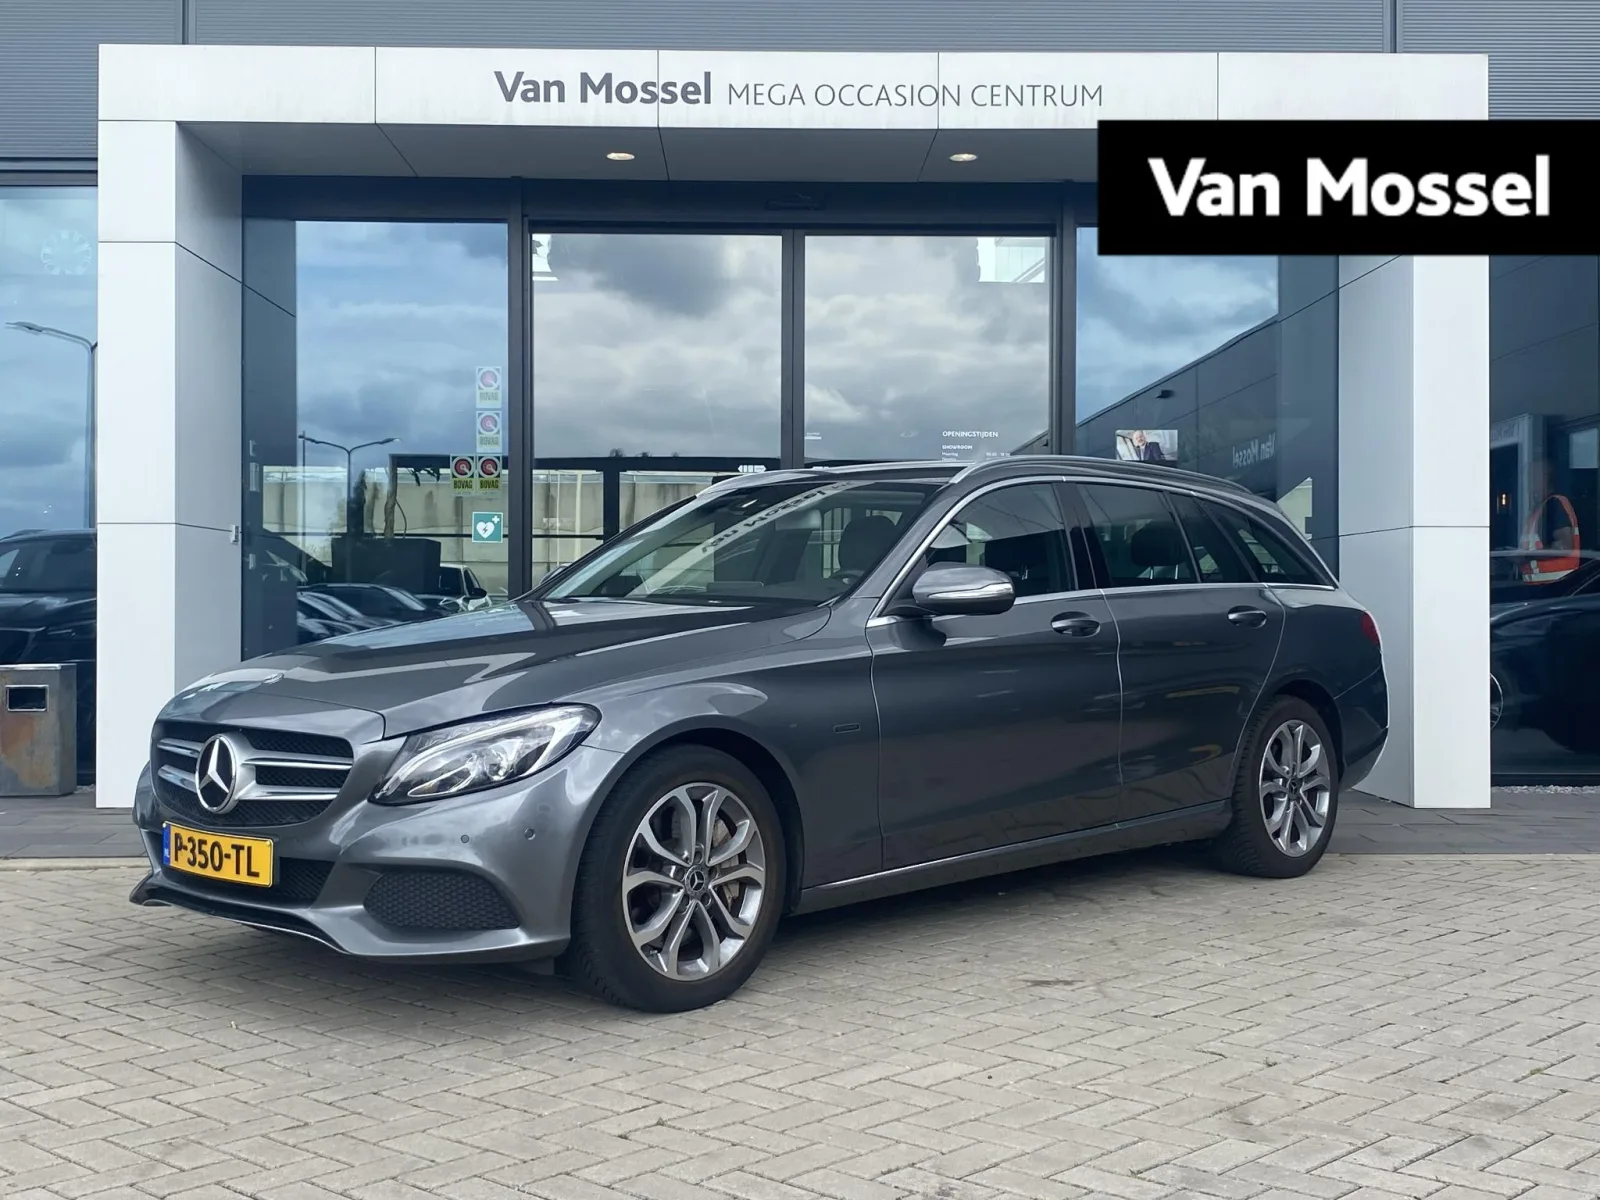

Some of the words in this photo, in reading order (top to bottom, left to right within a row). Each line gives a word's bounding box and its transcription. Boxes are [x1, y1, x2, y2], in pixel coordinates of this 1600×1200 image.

[494, 71, 566, 103] Van
[580, 71, 711, 104] Mossel
[728, 83, 806, 106] MEGA
[814, 84, 961, 107] OCCASION
[970, 84, 1103, 107] CENTRUM
[942, 430, 999, 439] OPENINGSTIJDEN
[453, 480, 472, 489] BOVAG
[480, 479, 499, 489] BOVAG
[174, 832, 260, 877] P-350-TL
